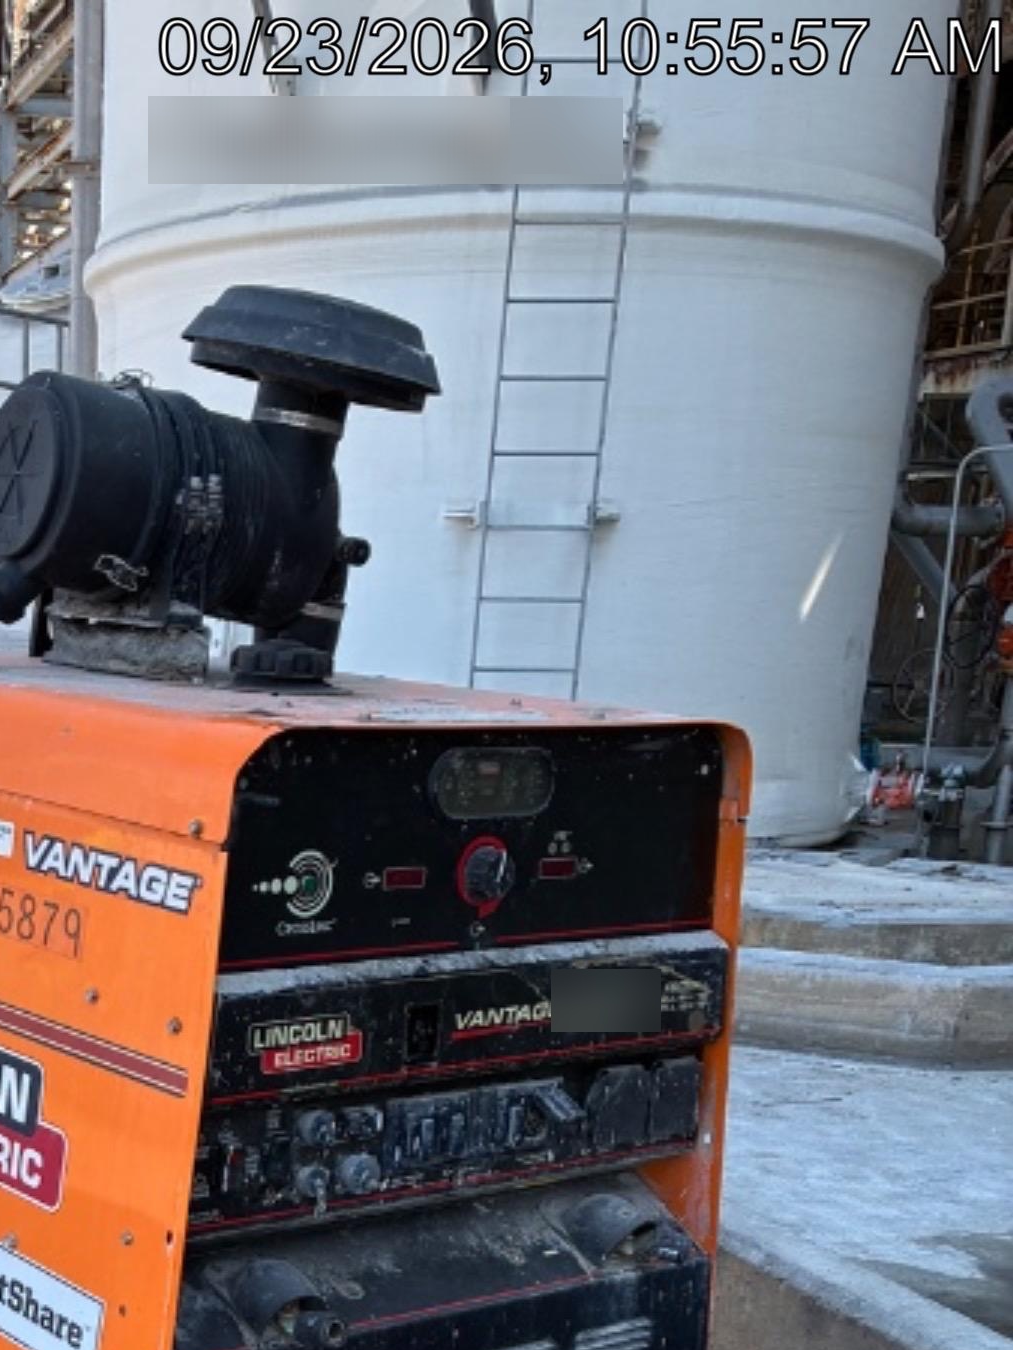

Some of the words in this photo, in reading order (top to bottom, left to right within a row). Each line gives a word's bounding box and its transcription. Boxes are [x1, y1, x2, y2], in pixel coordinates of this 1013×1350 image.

[22, 829, 197, 915] VANTAGE
[453, 999, 552, 1030] VANTAG
[253, 1018, 345, 1049] LINCOLN
[274, 1042, 352, 1069] ELECTRIC
